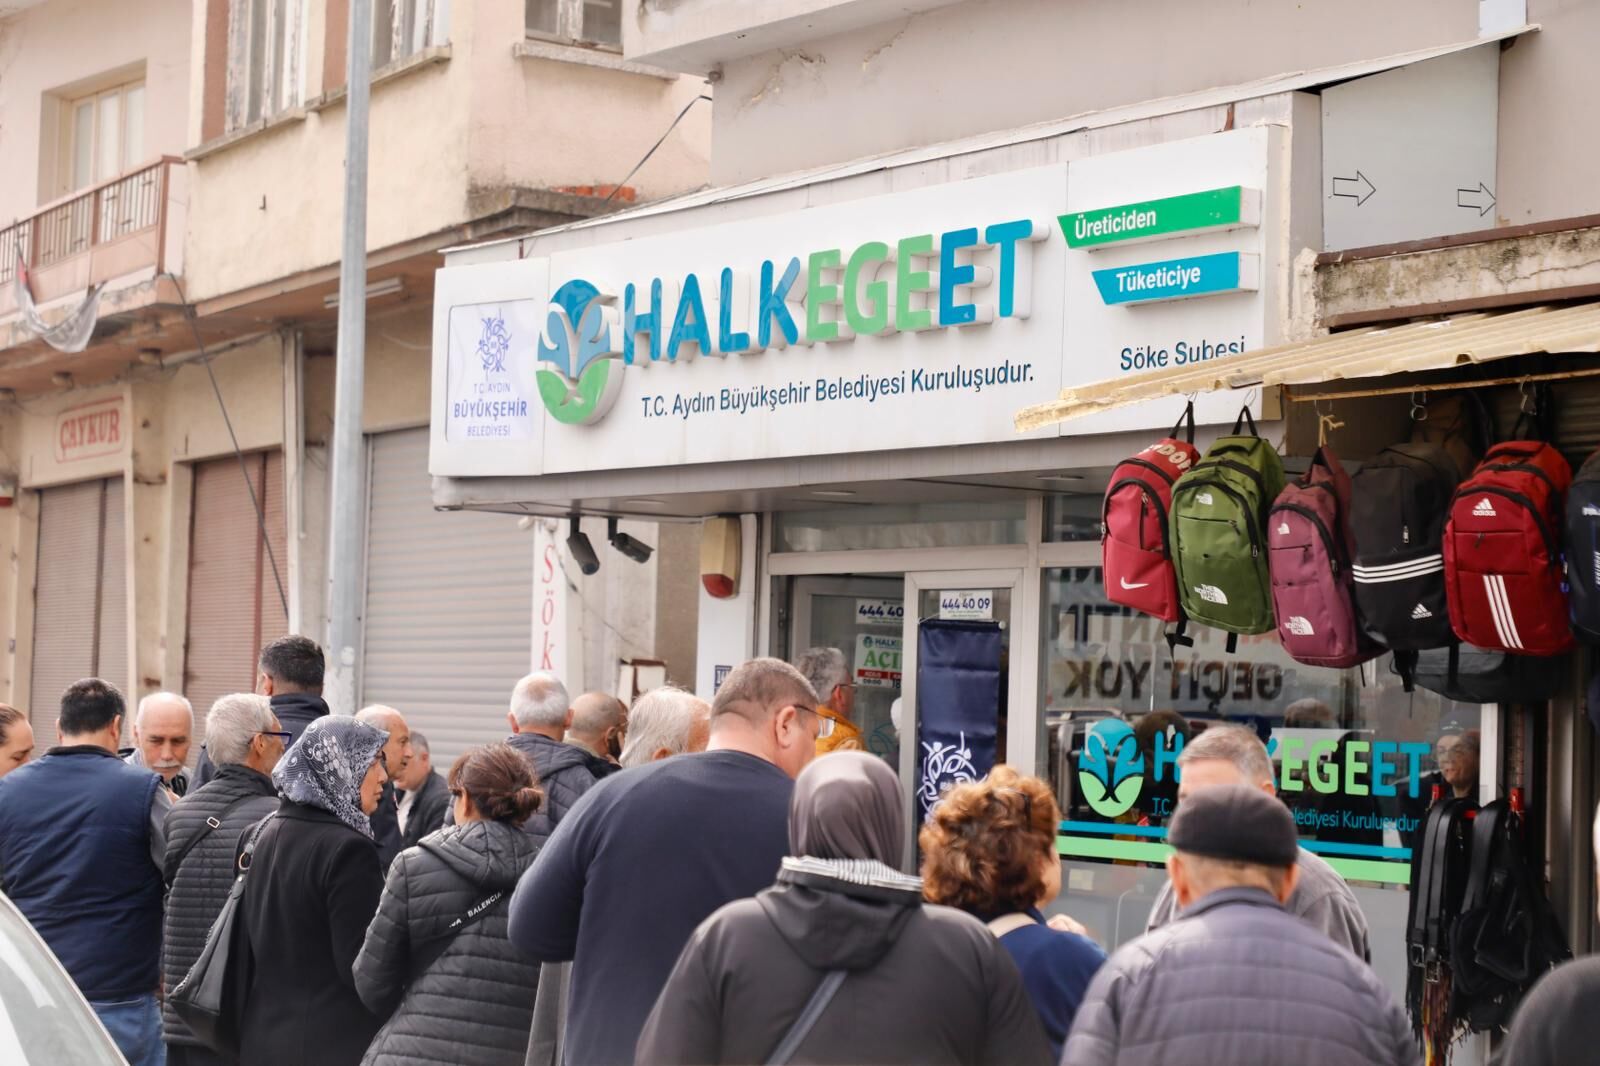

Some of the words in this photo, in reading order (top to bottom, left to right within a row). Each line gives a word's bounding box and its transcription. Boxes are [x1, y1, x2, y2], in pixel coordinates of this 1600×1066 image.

[1074, 209, 1157, 240] Üreticiden
[1115, 264, 1202, 292] Tüketiciye
[624, 218, 1034, 367] HALKEGEET
[1119, 345, 1169, 371] Söke
[641, 395, 669, 418] T.C.
[672, 391, 716, 420] Aydın
[720, 381, 811, 415] Büyükşehir
[815, 370, 905, 403] Belediyesi
[911, 359, 1034, 393] Kuruluşudur.
[453, 398, 528, 421] BÜYÜKŞEHİR
[60, 409, 120, 454] ÇAYKUR
[466, 423, 511, 437] BELEDİYESİ
[962, 597, 976, 610] 40
[977, 597, 990, 610] 09
[467, 891, 503, 918] BALENCIA
